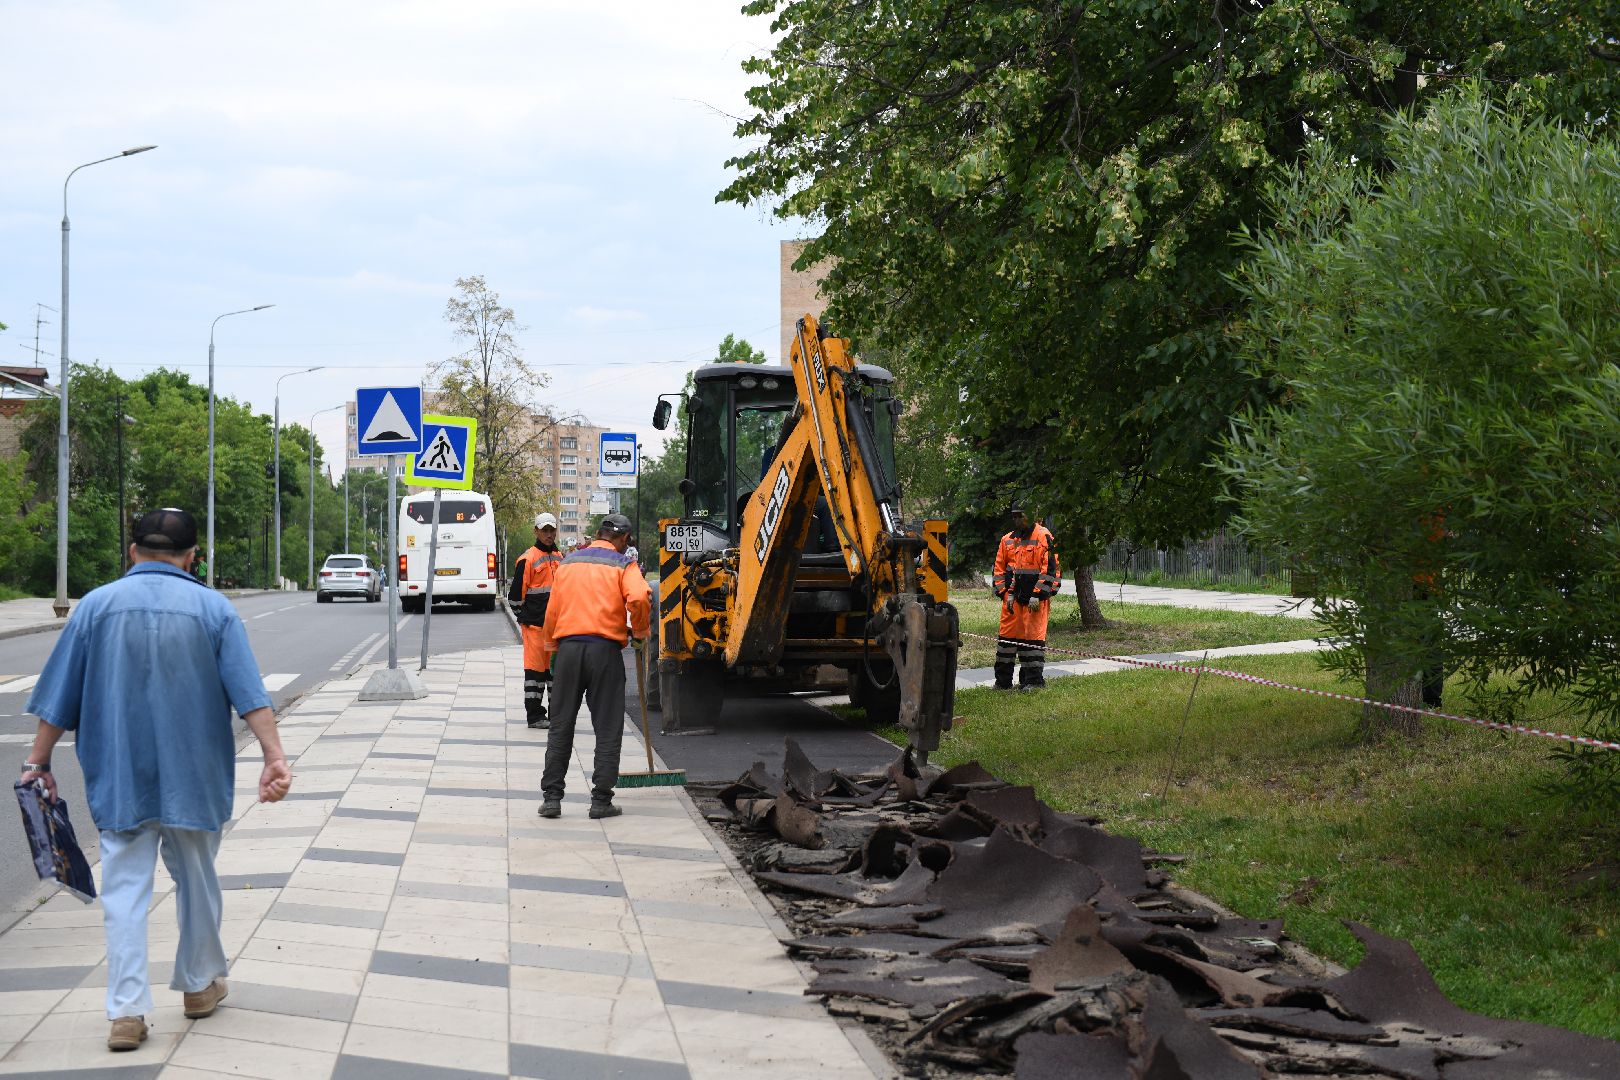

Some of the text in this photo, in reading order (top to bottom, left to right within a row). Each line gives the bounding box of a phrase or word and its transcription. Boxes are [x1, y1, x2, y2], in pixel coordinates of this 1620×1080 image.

[757, 465, 789, 562] JCB
[670, 526, 698, 538] 8815
[688, 539, 700, 547] 50
